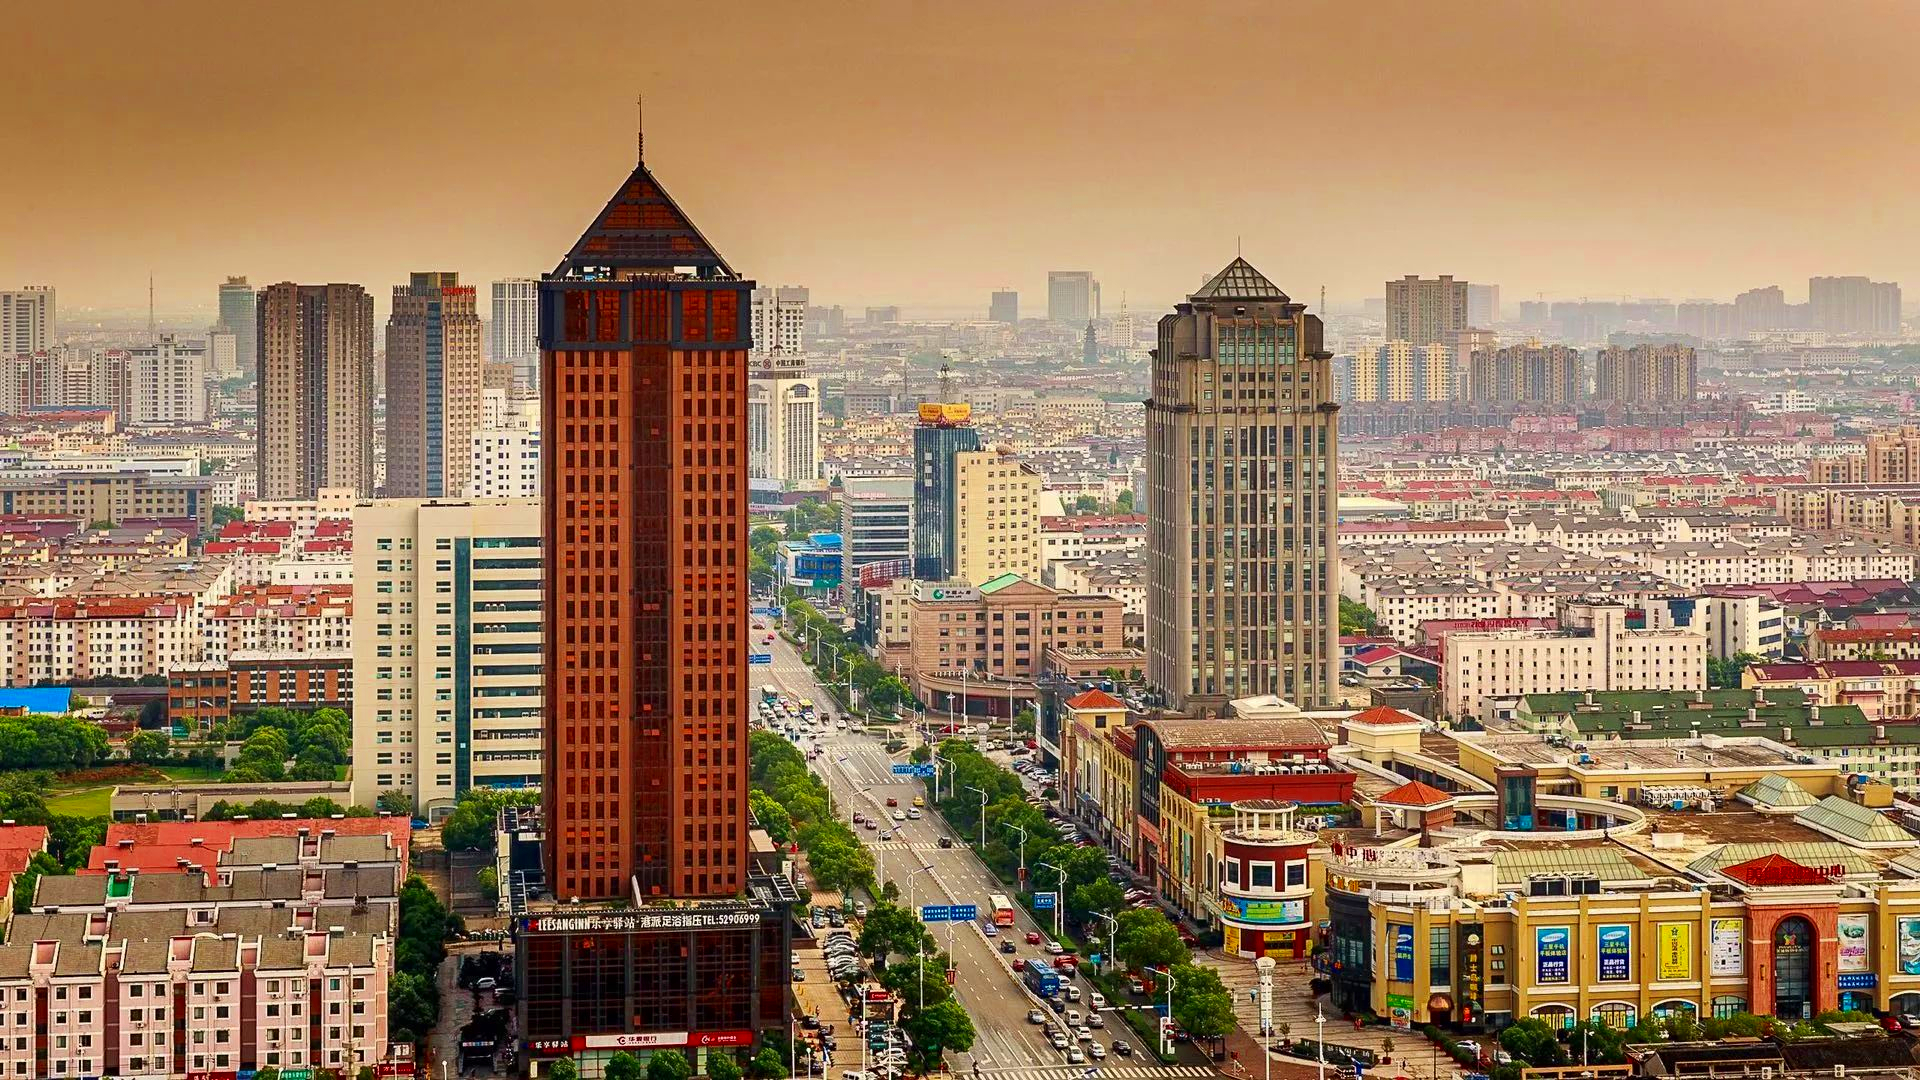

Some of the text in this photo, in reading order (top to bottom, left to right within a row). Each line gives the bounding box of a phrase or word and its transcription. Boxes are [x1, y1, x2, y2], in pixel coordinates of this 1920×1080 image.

[776, 359, 806, 367] 中国工商银行
[538, 917, 590, 931] LEESANGINN
[702, 913, 760, 925] TEL:52906999
